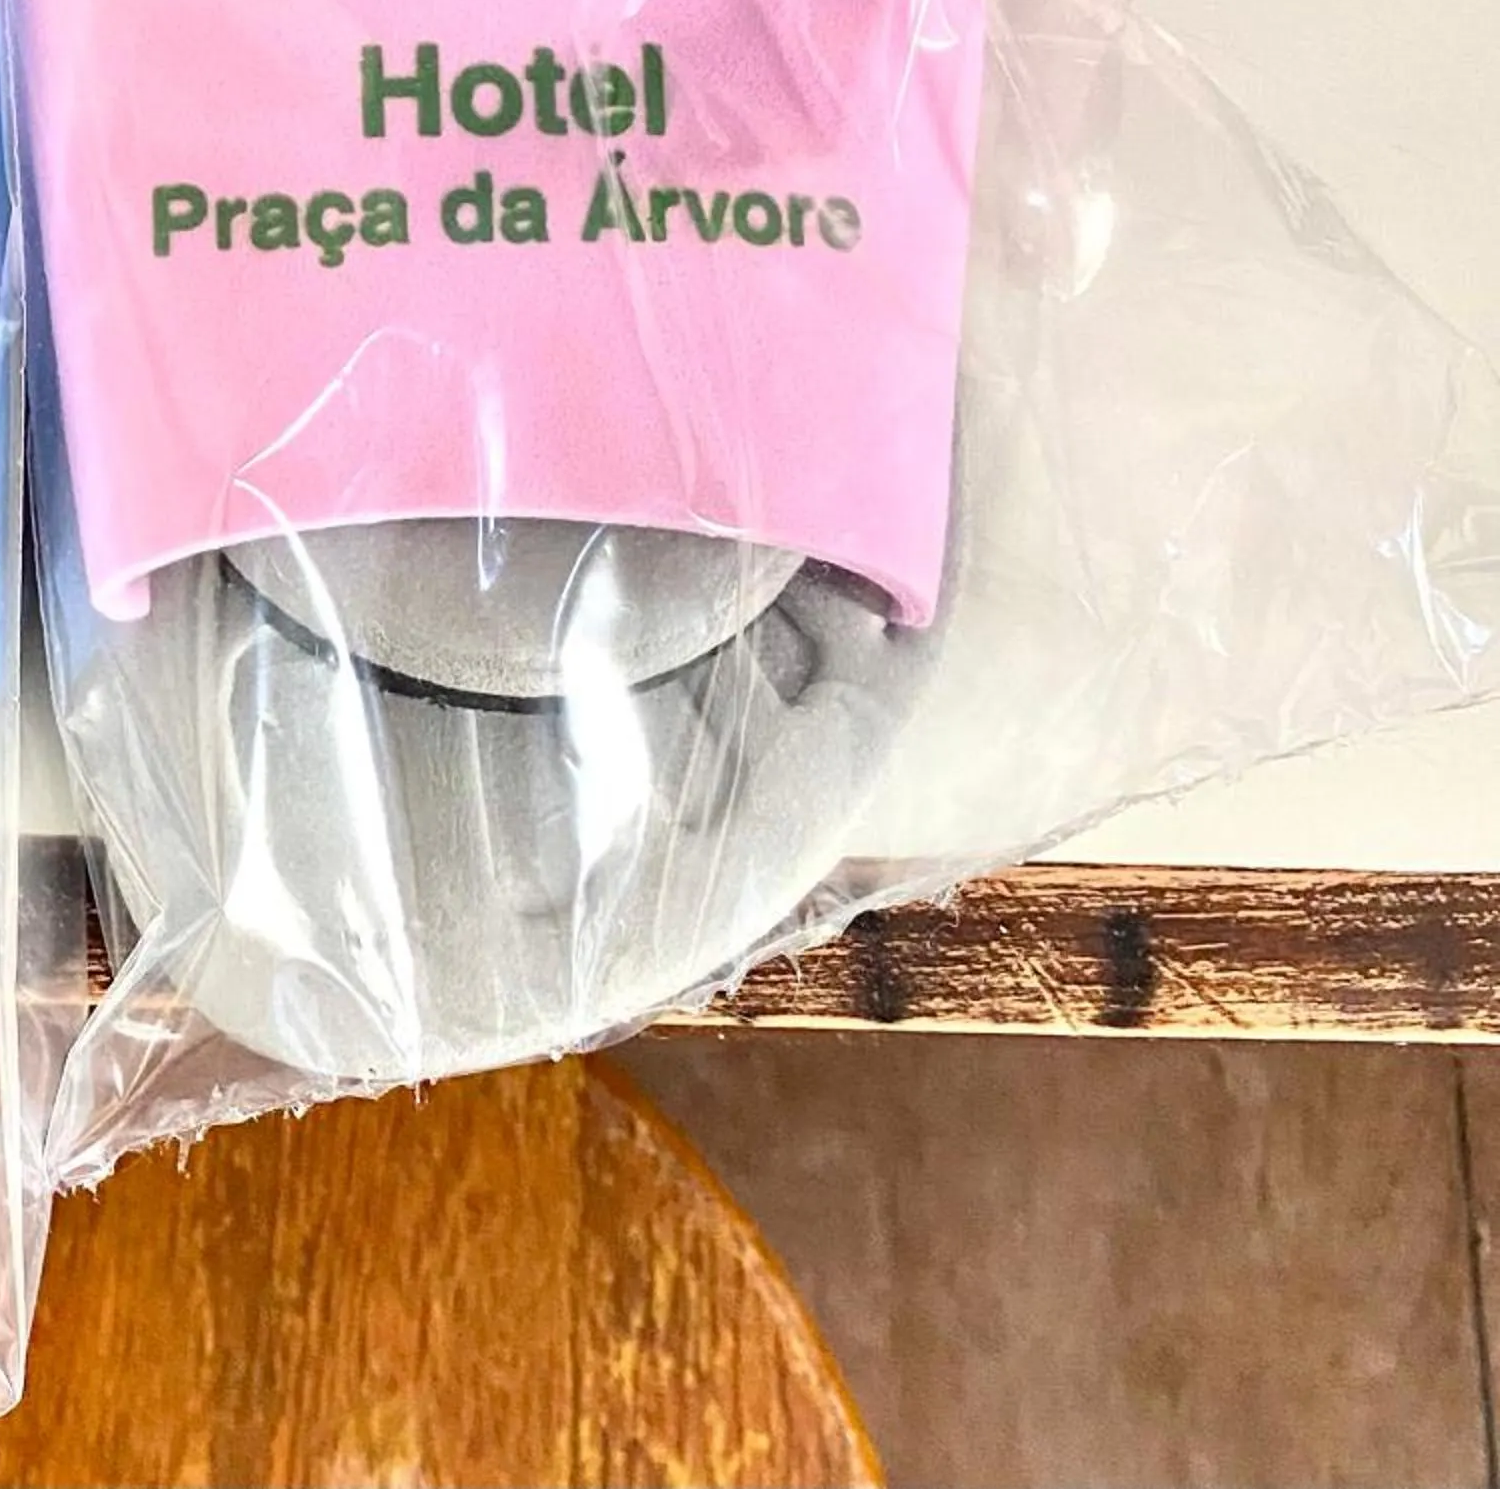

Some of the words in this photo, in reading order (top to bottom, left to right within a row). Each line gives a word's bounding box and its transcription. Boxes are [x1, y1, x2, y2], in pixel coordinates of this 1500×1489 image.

[359, 41, 668, 139] Hotel
[151, 182, 410, 268] Praça
[440, 170, 549, 245] da
[581, 149, 862, 252] Árvore
